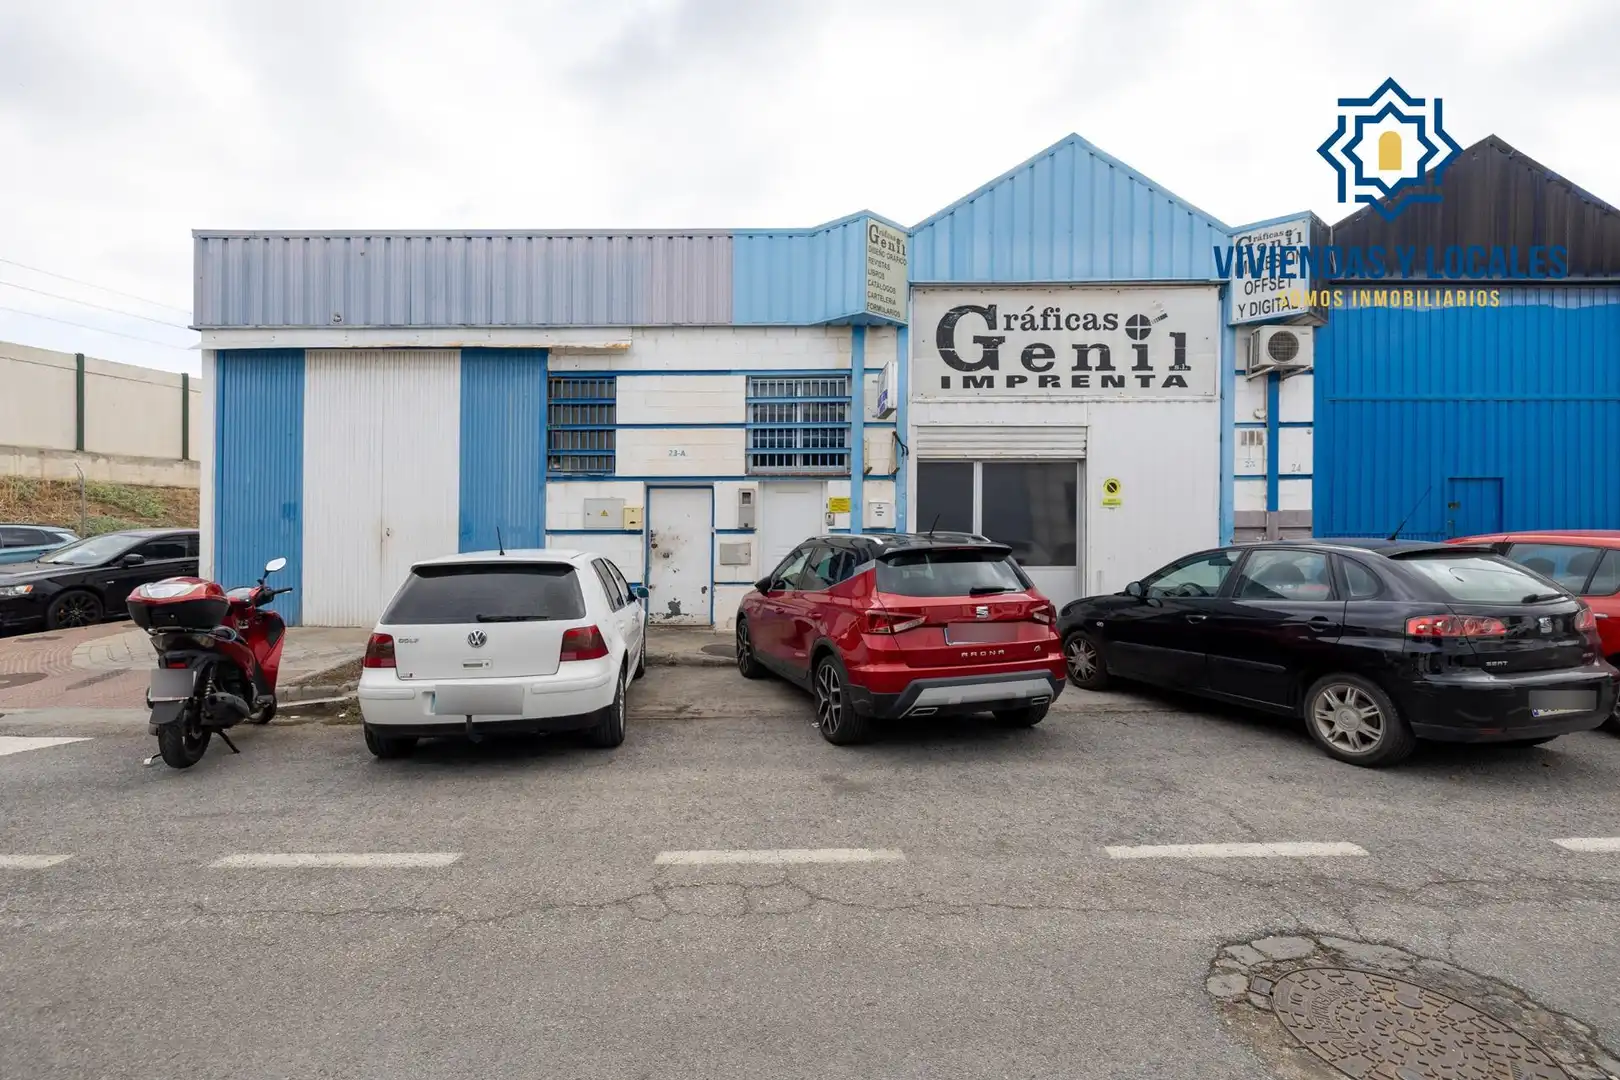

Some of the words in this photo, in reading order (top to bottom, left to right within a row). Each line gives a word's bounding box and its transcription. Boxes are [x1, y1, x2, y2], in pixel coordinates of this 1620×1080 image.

[868, 256, 891, 271] REVISTAS
[868, 269, 885, 280] LIBROS
[1244, 276, 1292, 295] OFFSET
[867, 303, 900, 318] FORMULARIOS
[1238, 303, 1246, 318] Y
[940, 374, 1189, 390] IMPRENTA
[1290, 462, 1302, 473] 24
[961, 649, 1006, 658] ARONA
